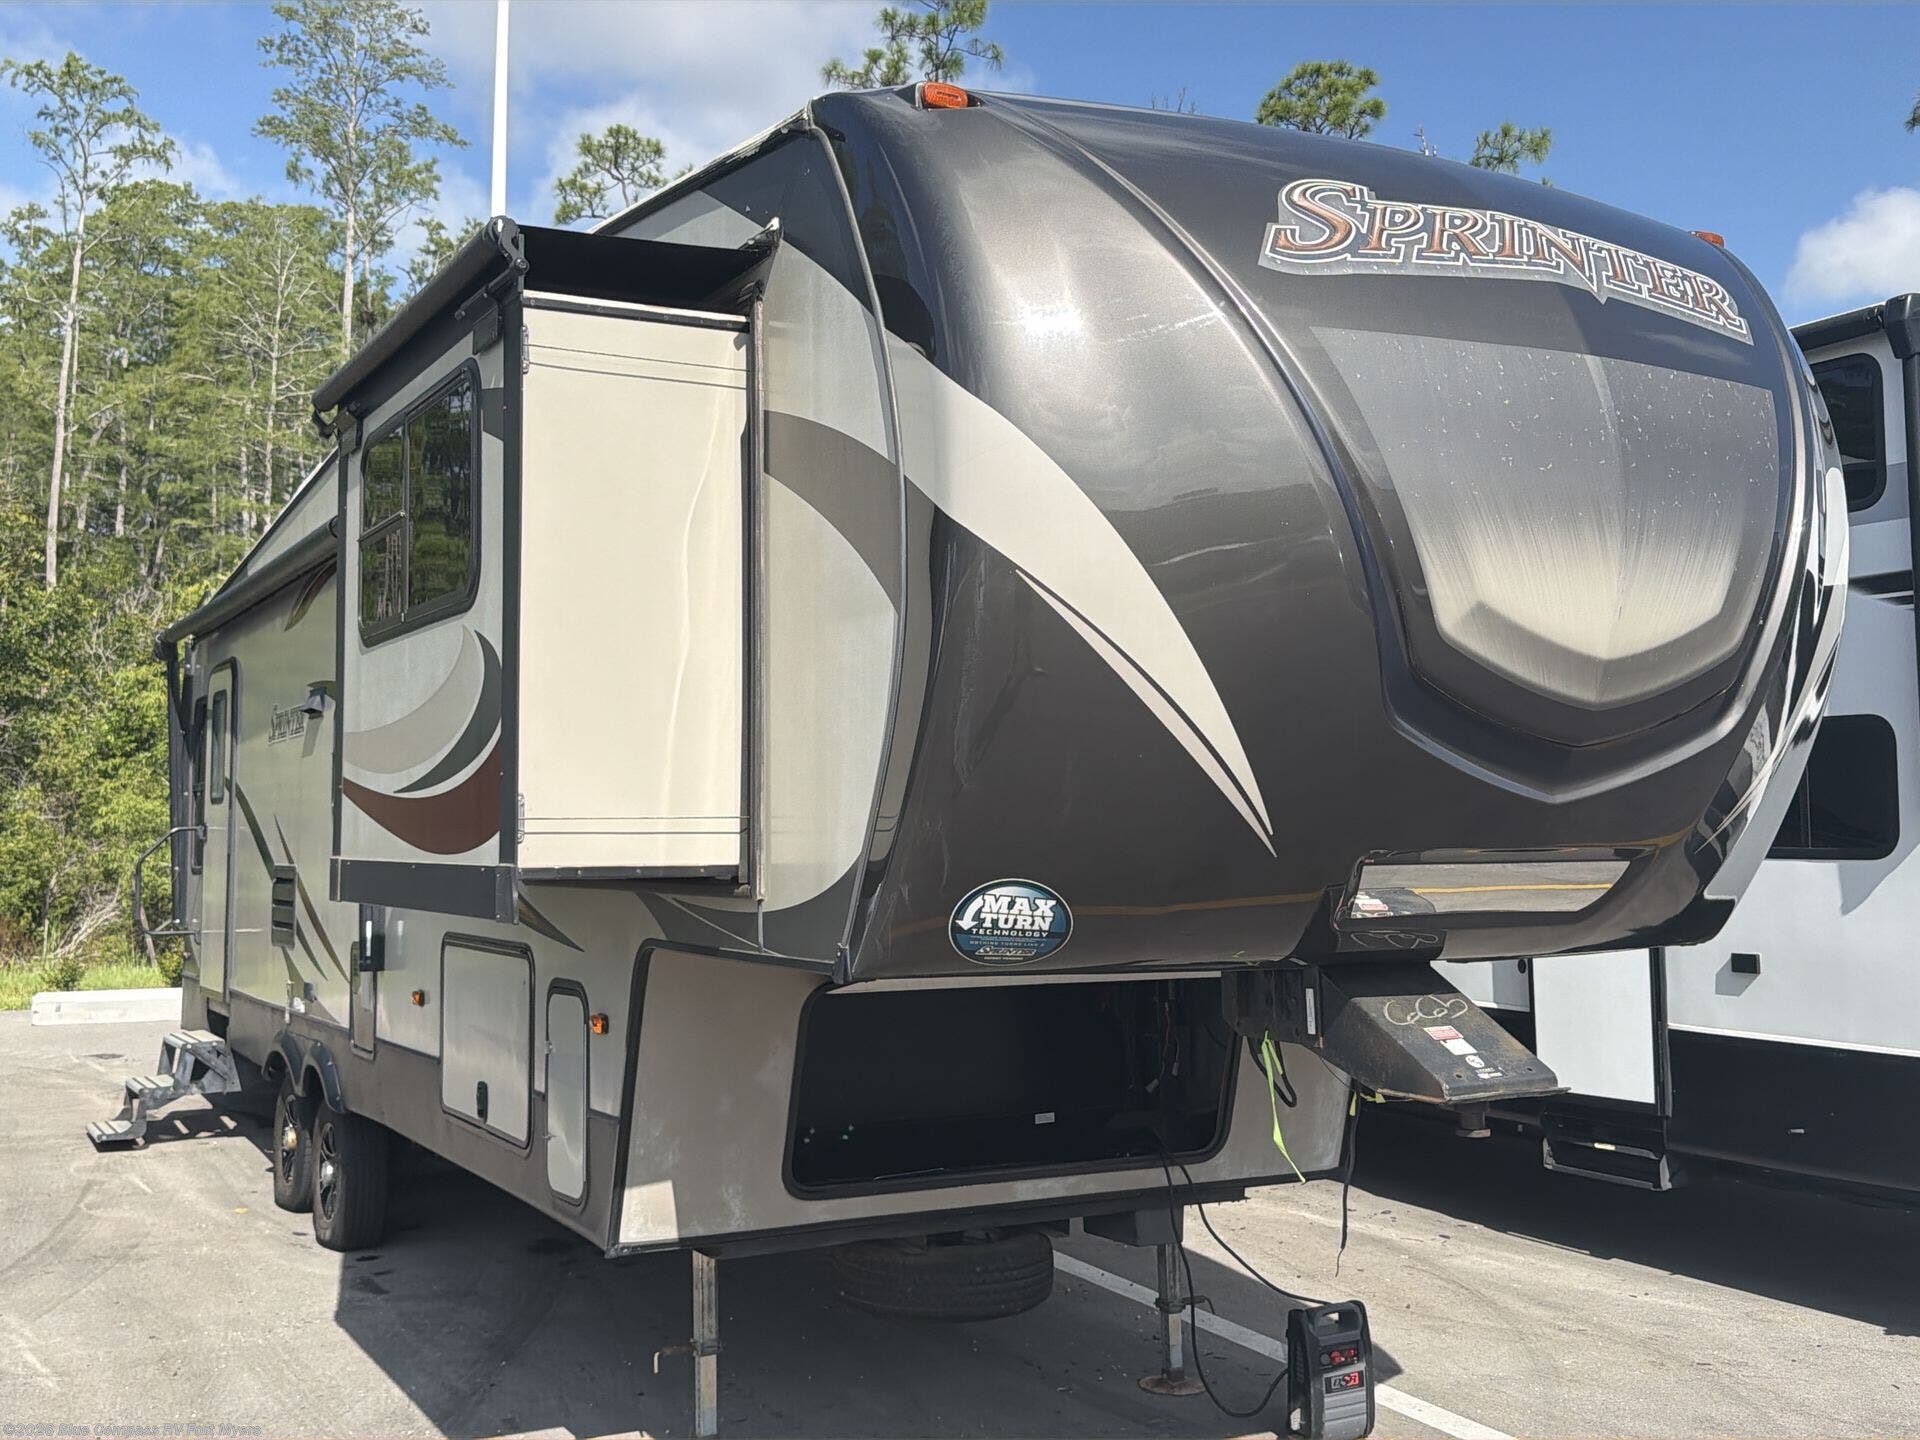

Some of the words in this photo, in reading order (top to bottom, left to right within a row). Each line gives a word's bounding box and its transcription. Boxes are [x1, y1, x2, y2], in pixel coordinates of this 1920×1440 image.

[1263, 178, 1749, 337] SPRINTER
[981, 893, 1057, 917] MAX
[979, 912, 1053, 931] TURN
[971, 927, 1049, 938] TECHNOLOGY
